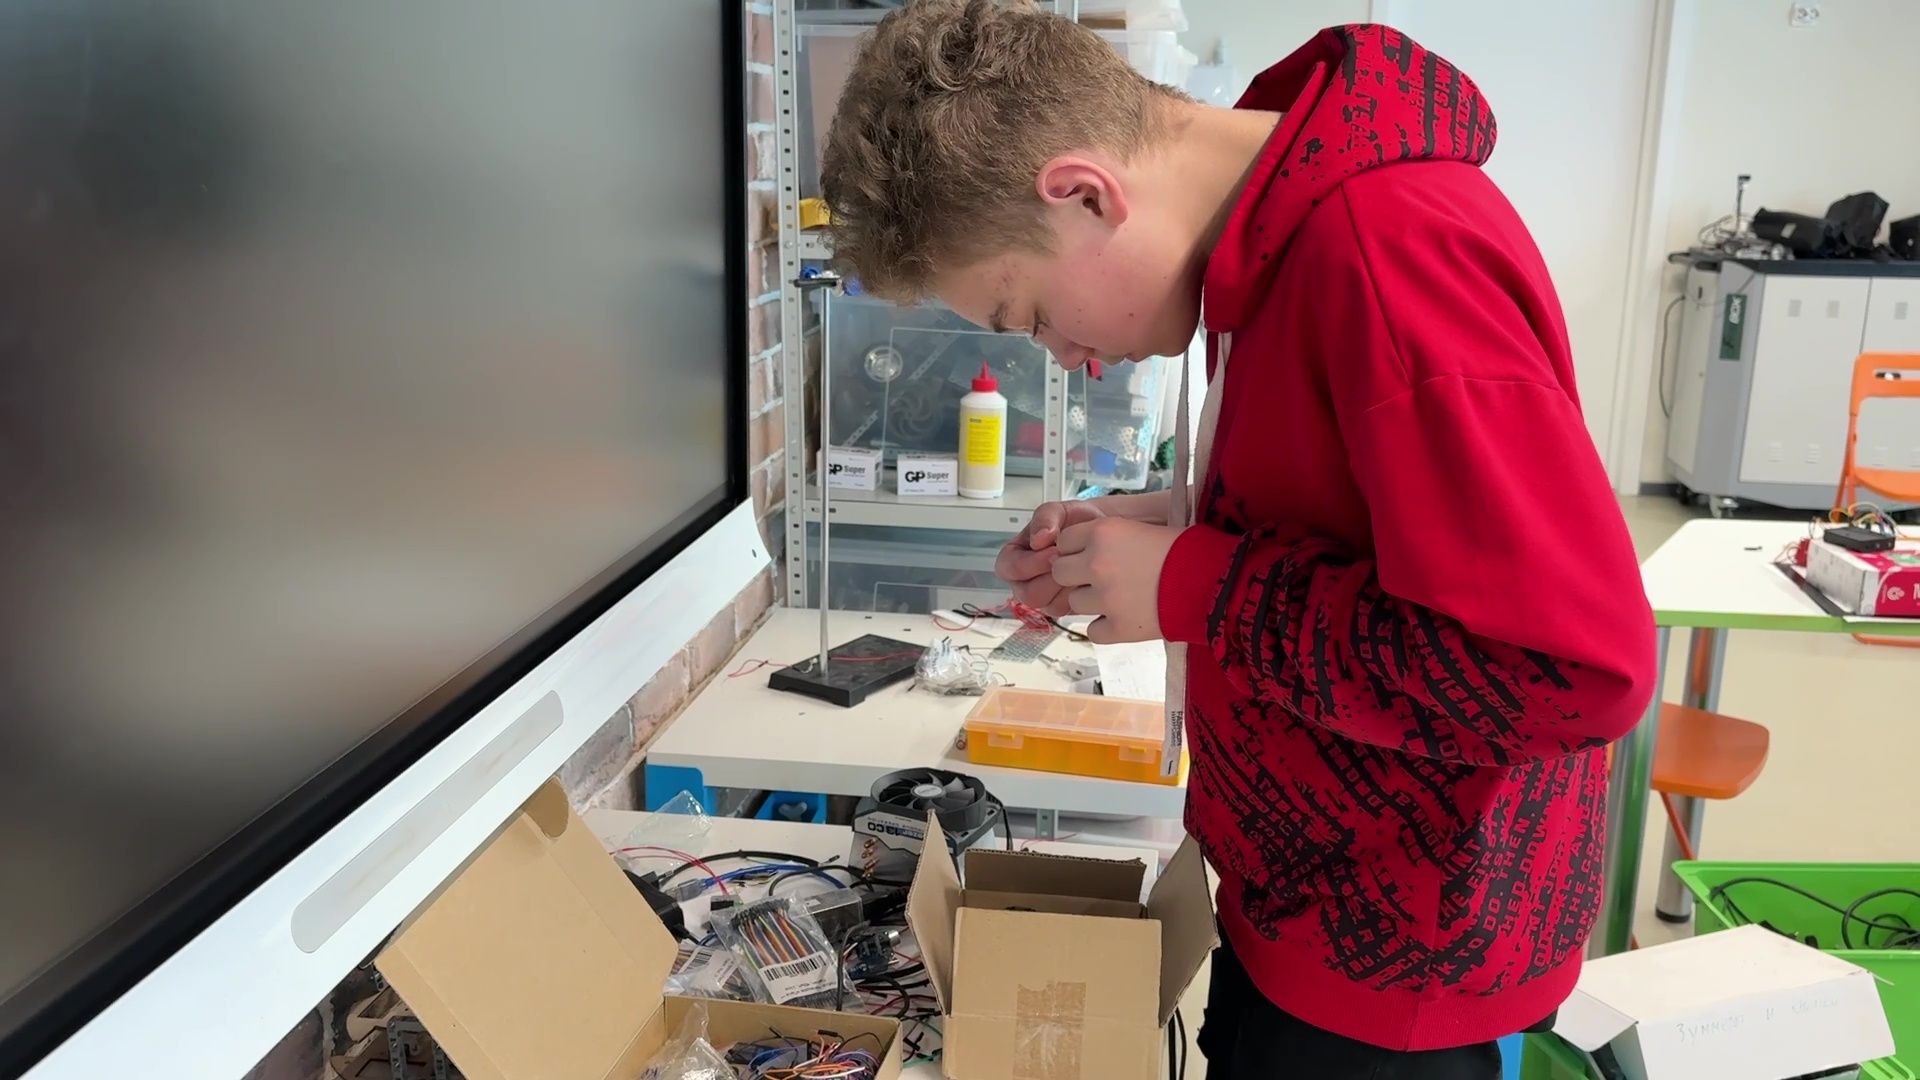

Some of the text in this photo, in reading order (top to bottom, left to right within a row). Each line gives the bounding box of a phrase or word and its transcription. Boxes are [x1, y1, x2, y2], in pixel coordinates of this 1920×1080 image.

[844, 465, 866, 474] Super
[905, 470, 950, 483] GP Super
